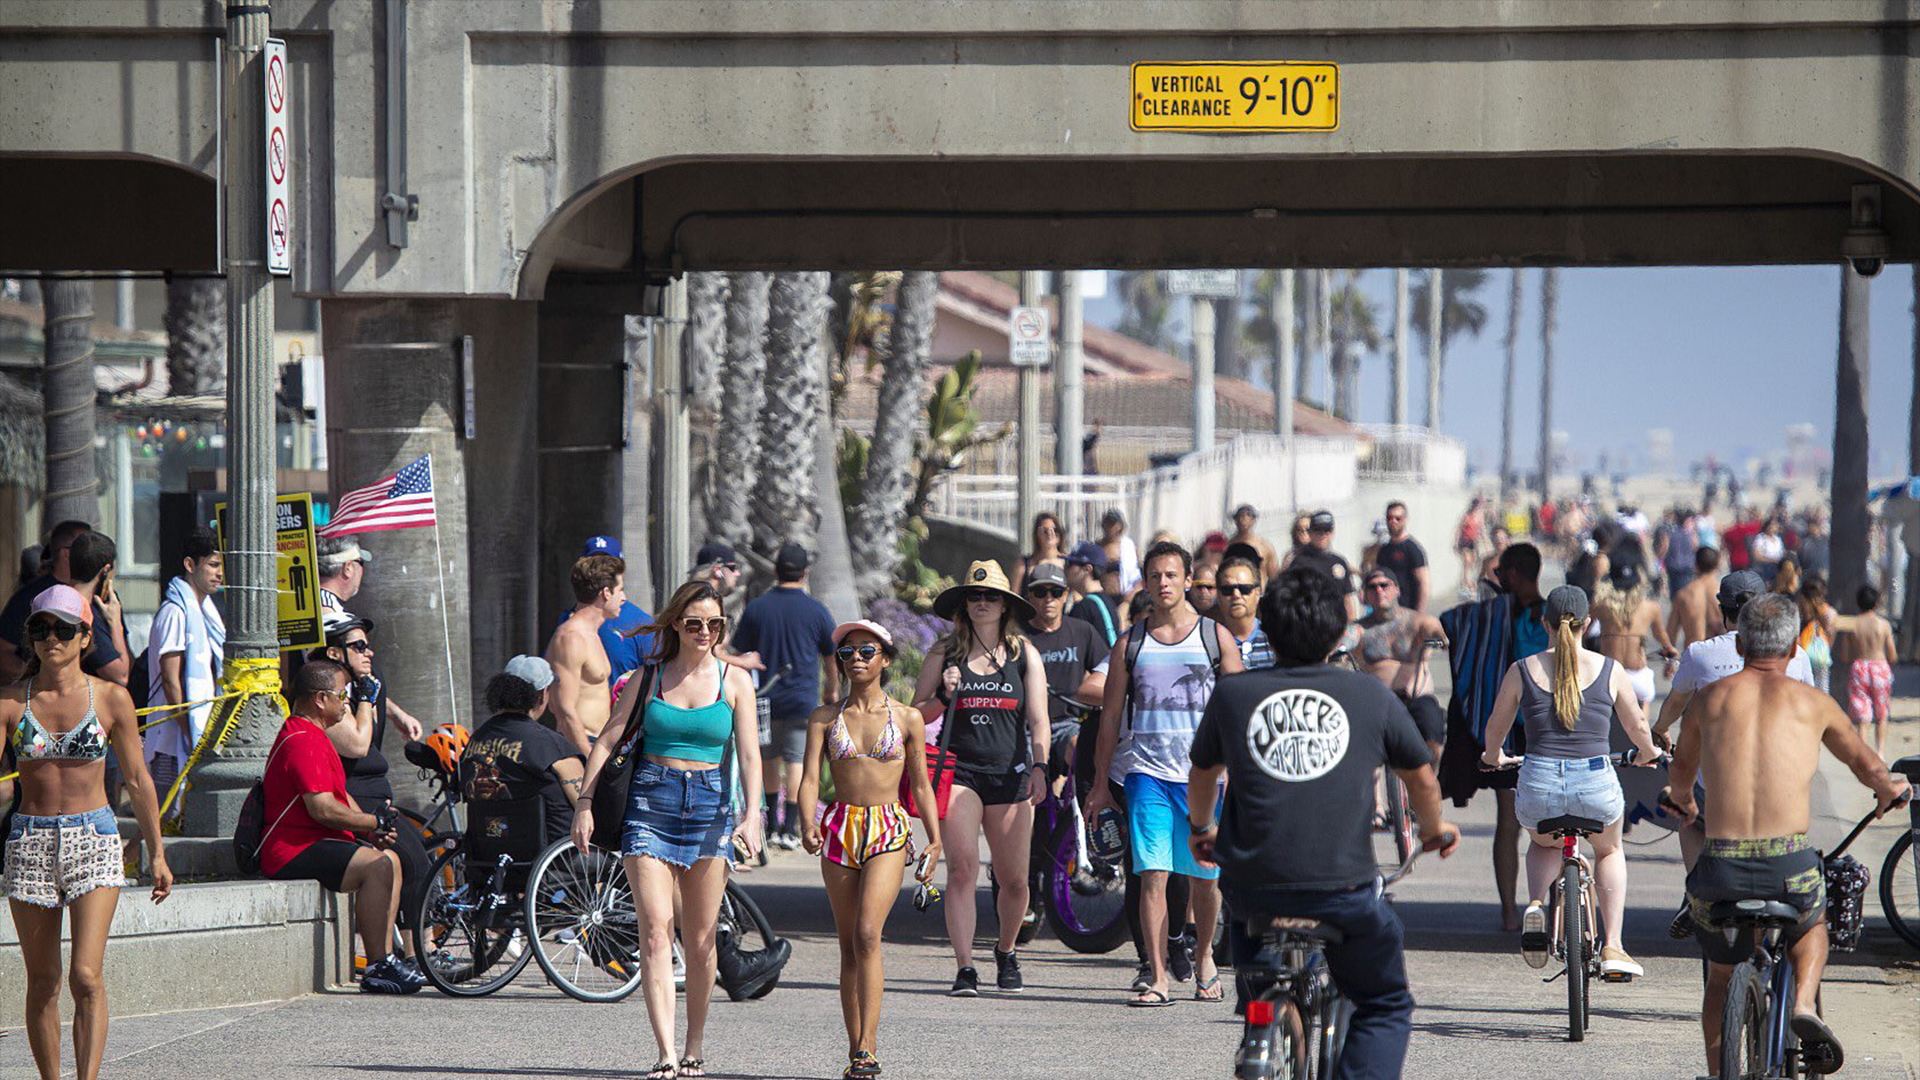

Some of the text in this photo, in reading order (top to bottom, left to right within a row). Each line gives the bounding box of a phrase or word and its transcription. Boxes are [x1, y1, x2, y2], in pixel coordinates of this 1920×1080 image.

[1151, 75, 1224, 93] VERTICAL
[1142, 98, 1232, 117] CLEARANCE
[956, 681, 1014, 694] IAMOND
[961, 696, 1003, 709] SUPPLY
[969, 713, 993, 725] CO.
